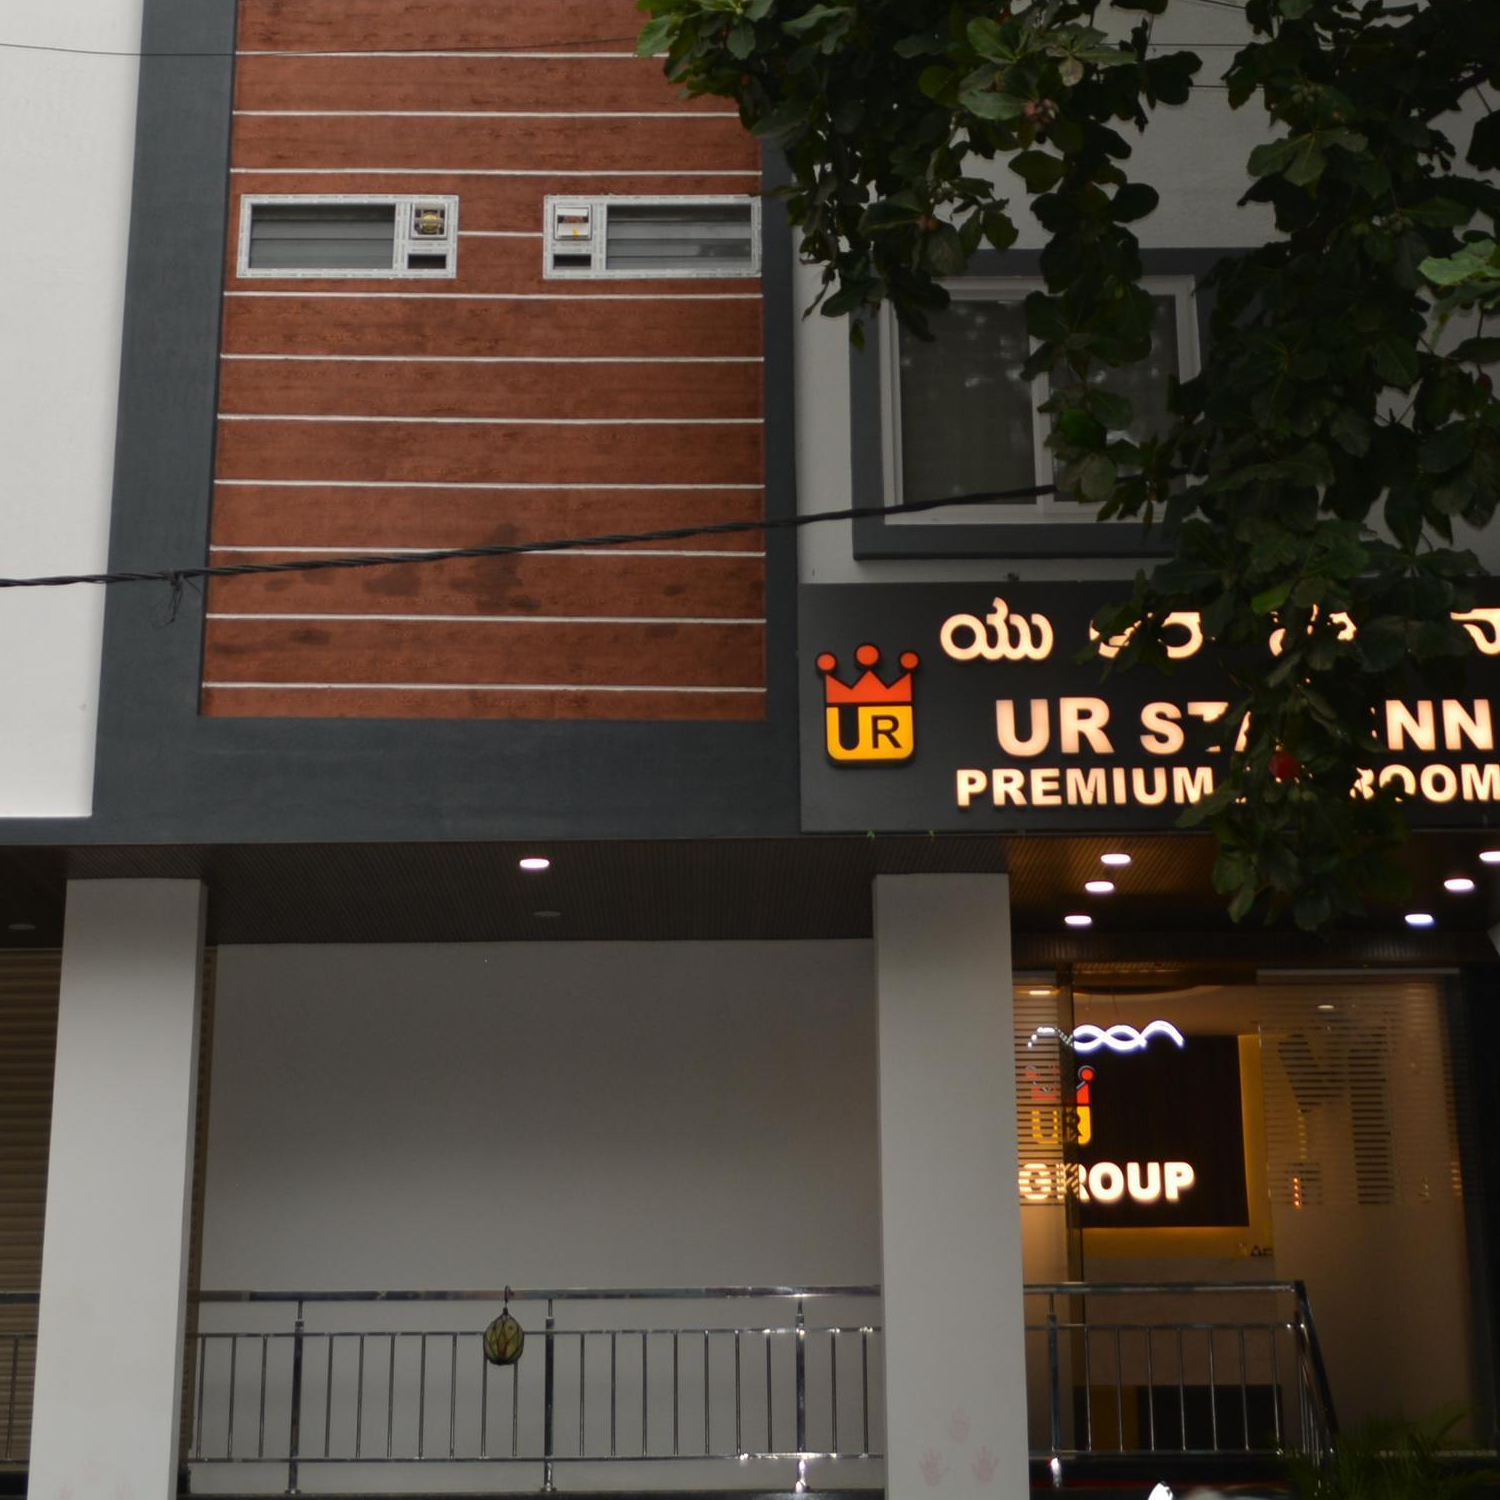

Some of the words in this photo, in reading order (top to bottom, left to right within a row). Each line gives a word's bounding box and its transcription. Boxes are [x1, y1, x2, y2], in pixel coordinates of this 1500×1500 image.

[838, 705, 903, 752] UR
[996, 697, 1114, 757] UR
[1368, 699, 1494, 751] NN
[956, 766, 1214, 807] PREMIUM
[1018, 1161, 1195, 1202] GROUP
